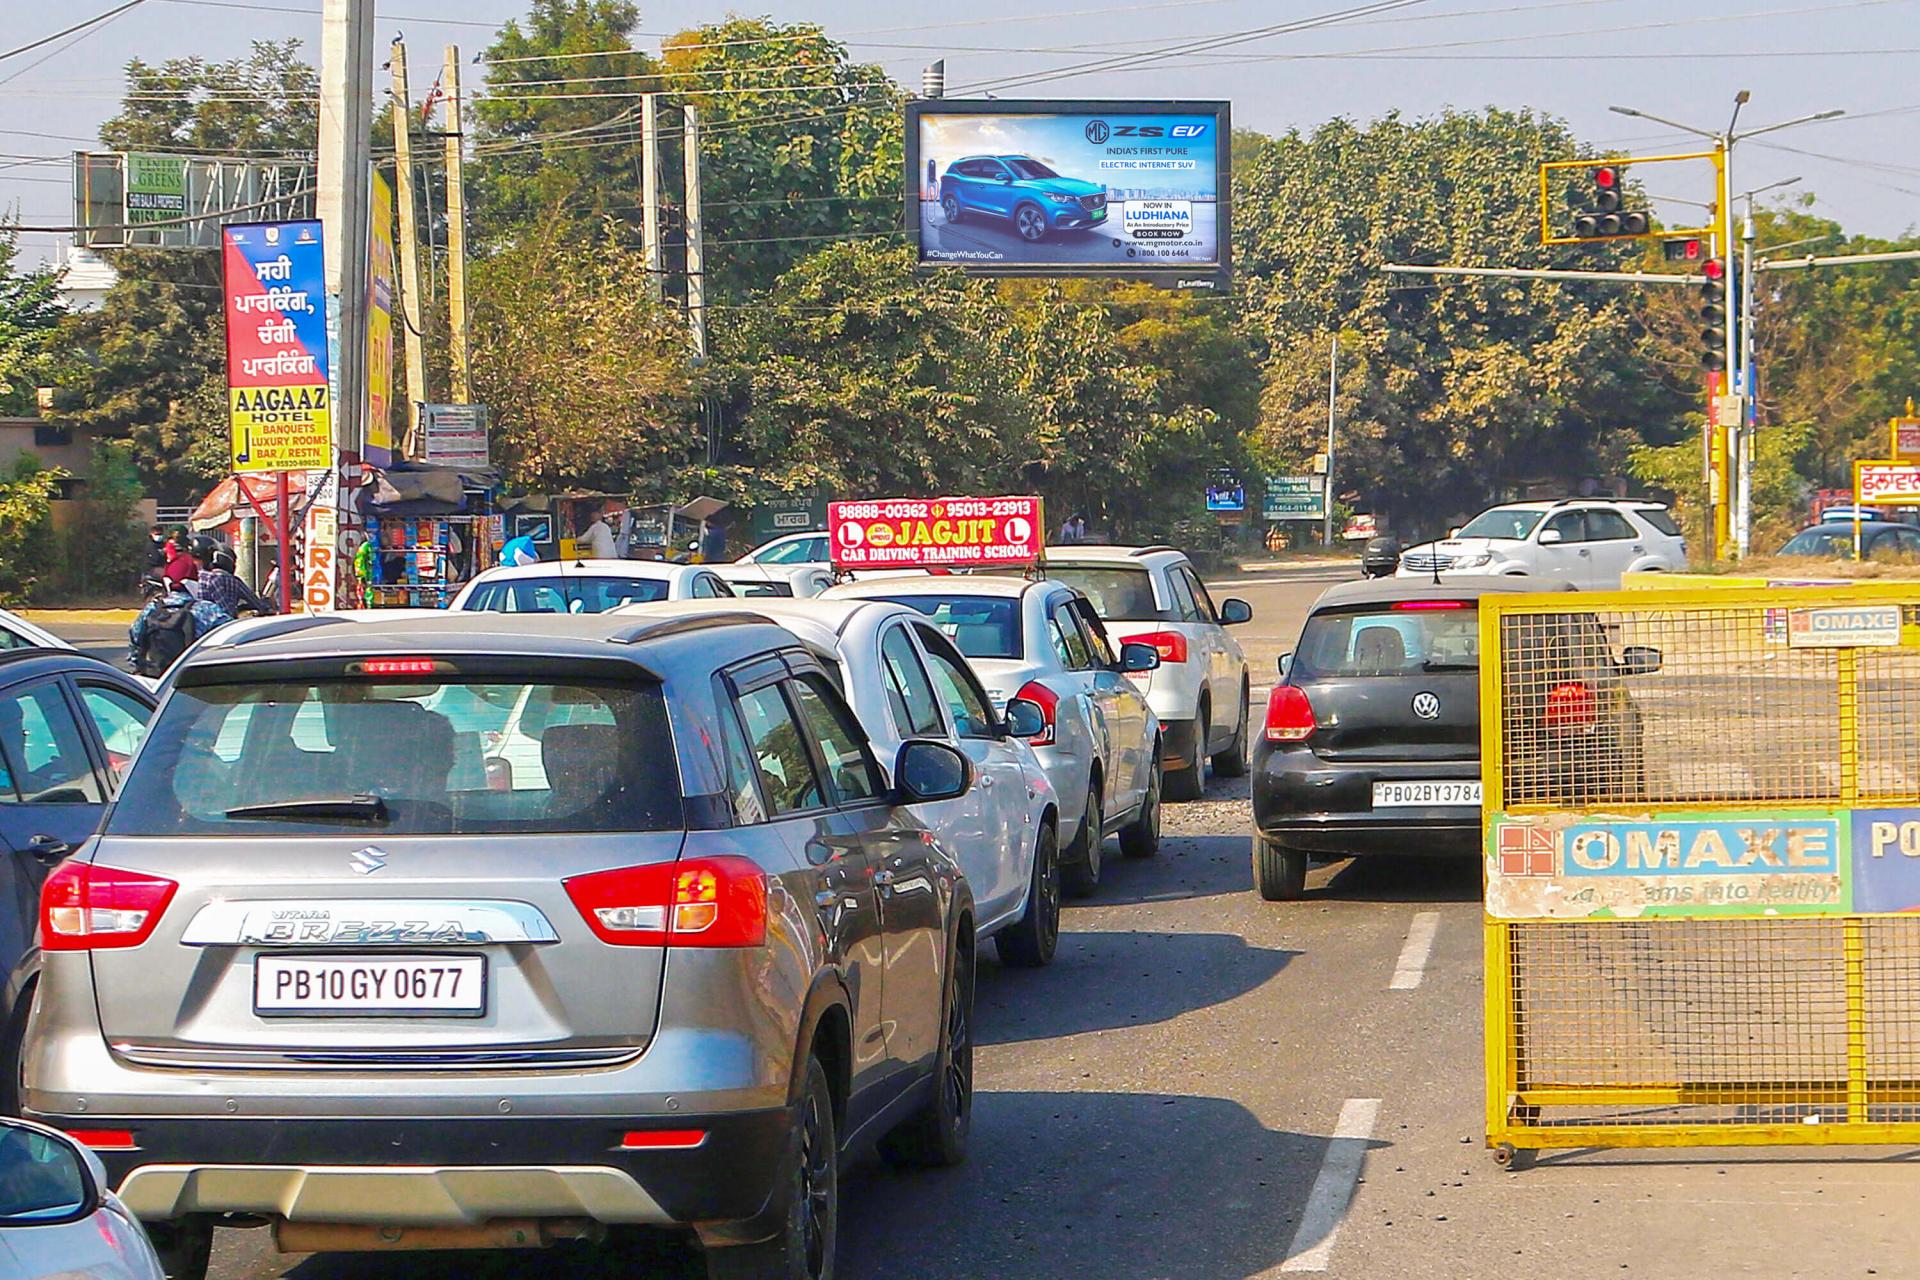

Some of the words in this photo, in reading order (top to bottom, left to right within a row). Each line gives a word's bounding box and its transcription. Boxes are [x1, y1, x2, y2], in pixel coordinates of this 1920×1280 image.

[1113, 126, 1165, 137] ZS
[1172, 125, 1205, 137] EV
[1106, 147, 1138, 155] INDIA'S
[1140, 147, 1163, 155] FIRST
[1165, 147, 1189, 155] PURE
[1139, 161, 1176, 169] INTERNET
[139, 172, 182, 187] GREENS
[1126, 211, 1189, 220] LUDHIANA
[1124, 239, 1203, 248] www.mgmotor.co.in
[927, 250, 1003, 259] #ChangeWhatYouCan
[1138, 249, 1155, 257] 1800
[1157, 249, 1170, 257] 100
[1172, 249, 1189, 257] 6464
[255, 254, 292, 280] ਸਹੀ
[234, 285, 315, 315] ਪਾਰਕਿੰਗ,
[257, 318, 297, 344] ਚੰਗੀ
[242, 349, 315, 377] ਪਾਰਕਿੰਗ
[234, 388, 326, 412] AAGAAZ
[251, 412, 314, 423] HOTEL
[263, 424, 316, 434] BANQUETS
[251, 437, 290, 447] LUXURY
[292, 435, 328, 446] ROOMS
[256, 449, 277, 459] BAR
[288, 447, 322, 458] RESTN.
[838, 503, 928, 519] 98888-00362
[947, 501, 1031, 517] 95013-23913
[843, 525, 857, 546] L
[895, 519, 996, 545] JAGJIT
[1010, 521, 1024, 541] L
[841, 549, 865, 561] CAR
[869, 547, 918, 561] DRIVING
[922, 546, 981, 560] TRAINING
[985, 545, 1031, 559] SCHOOL
[1814, 612, 1897, 630] OMAXE
[1571, 827, 1829, 870] OMAXE
[1702, 882, 1750, 900] into
[272, 910, 331, 920] VITARA
[264, 920, 468, 942] BREZZA
